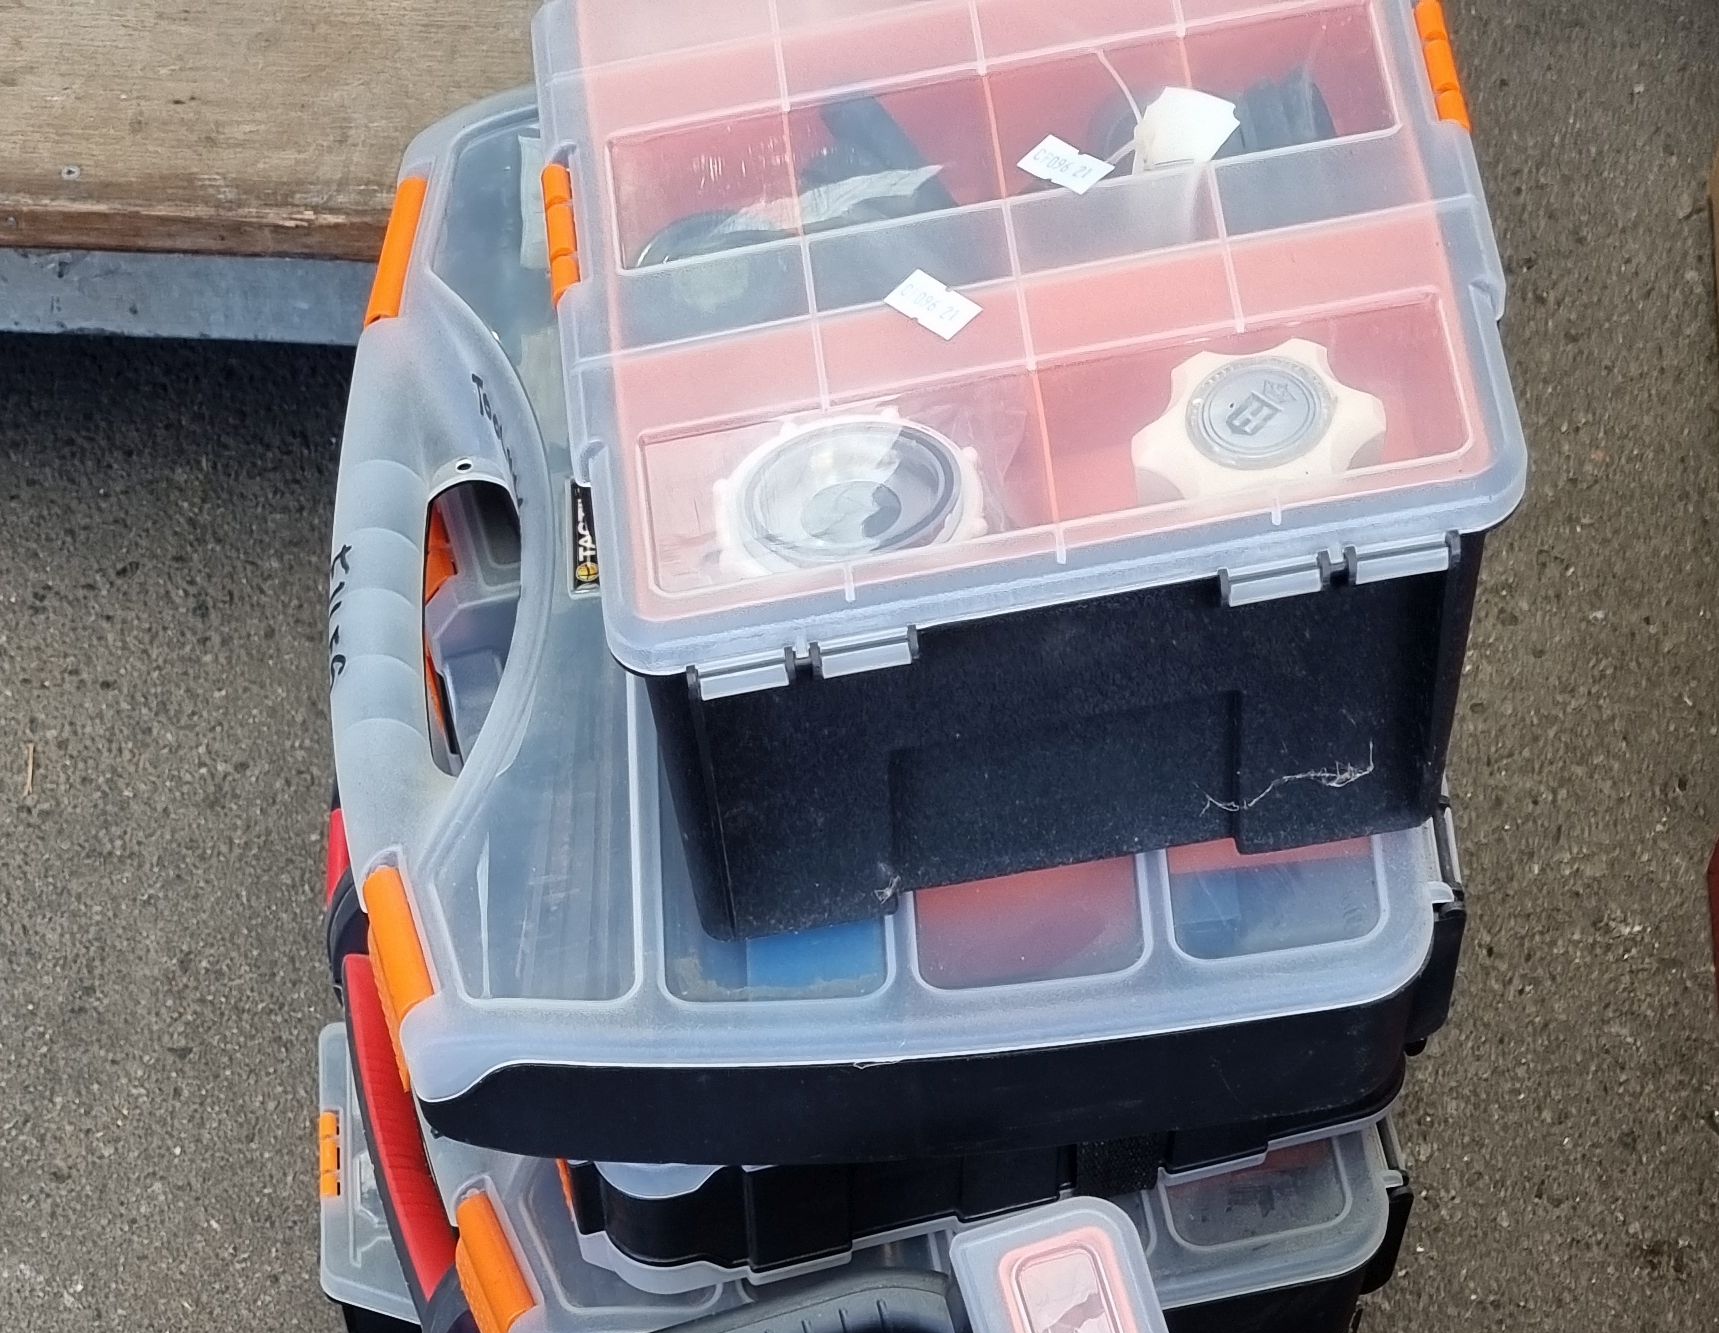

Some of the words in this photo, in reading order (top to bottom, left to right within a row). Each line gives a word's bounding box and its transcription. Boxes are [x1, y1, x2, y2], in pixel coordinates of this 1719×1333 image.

[1071, 165, 1093, 179] 21
[900, 283, 939, 312] C096
[938, 305, 961, 321] 21
